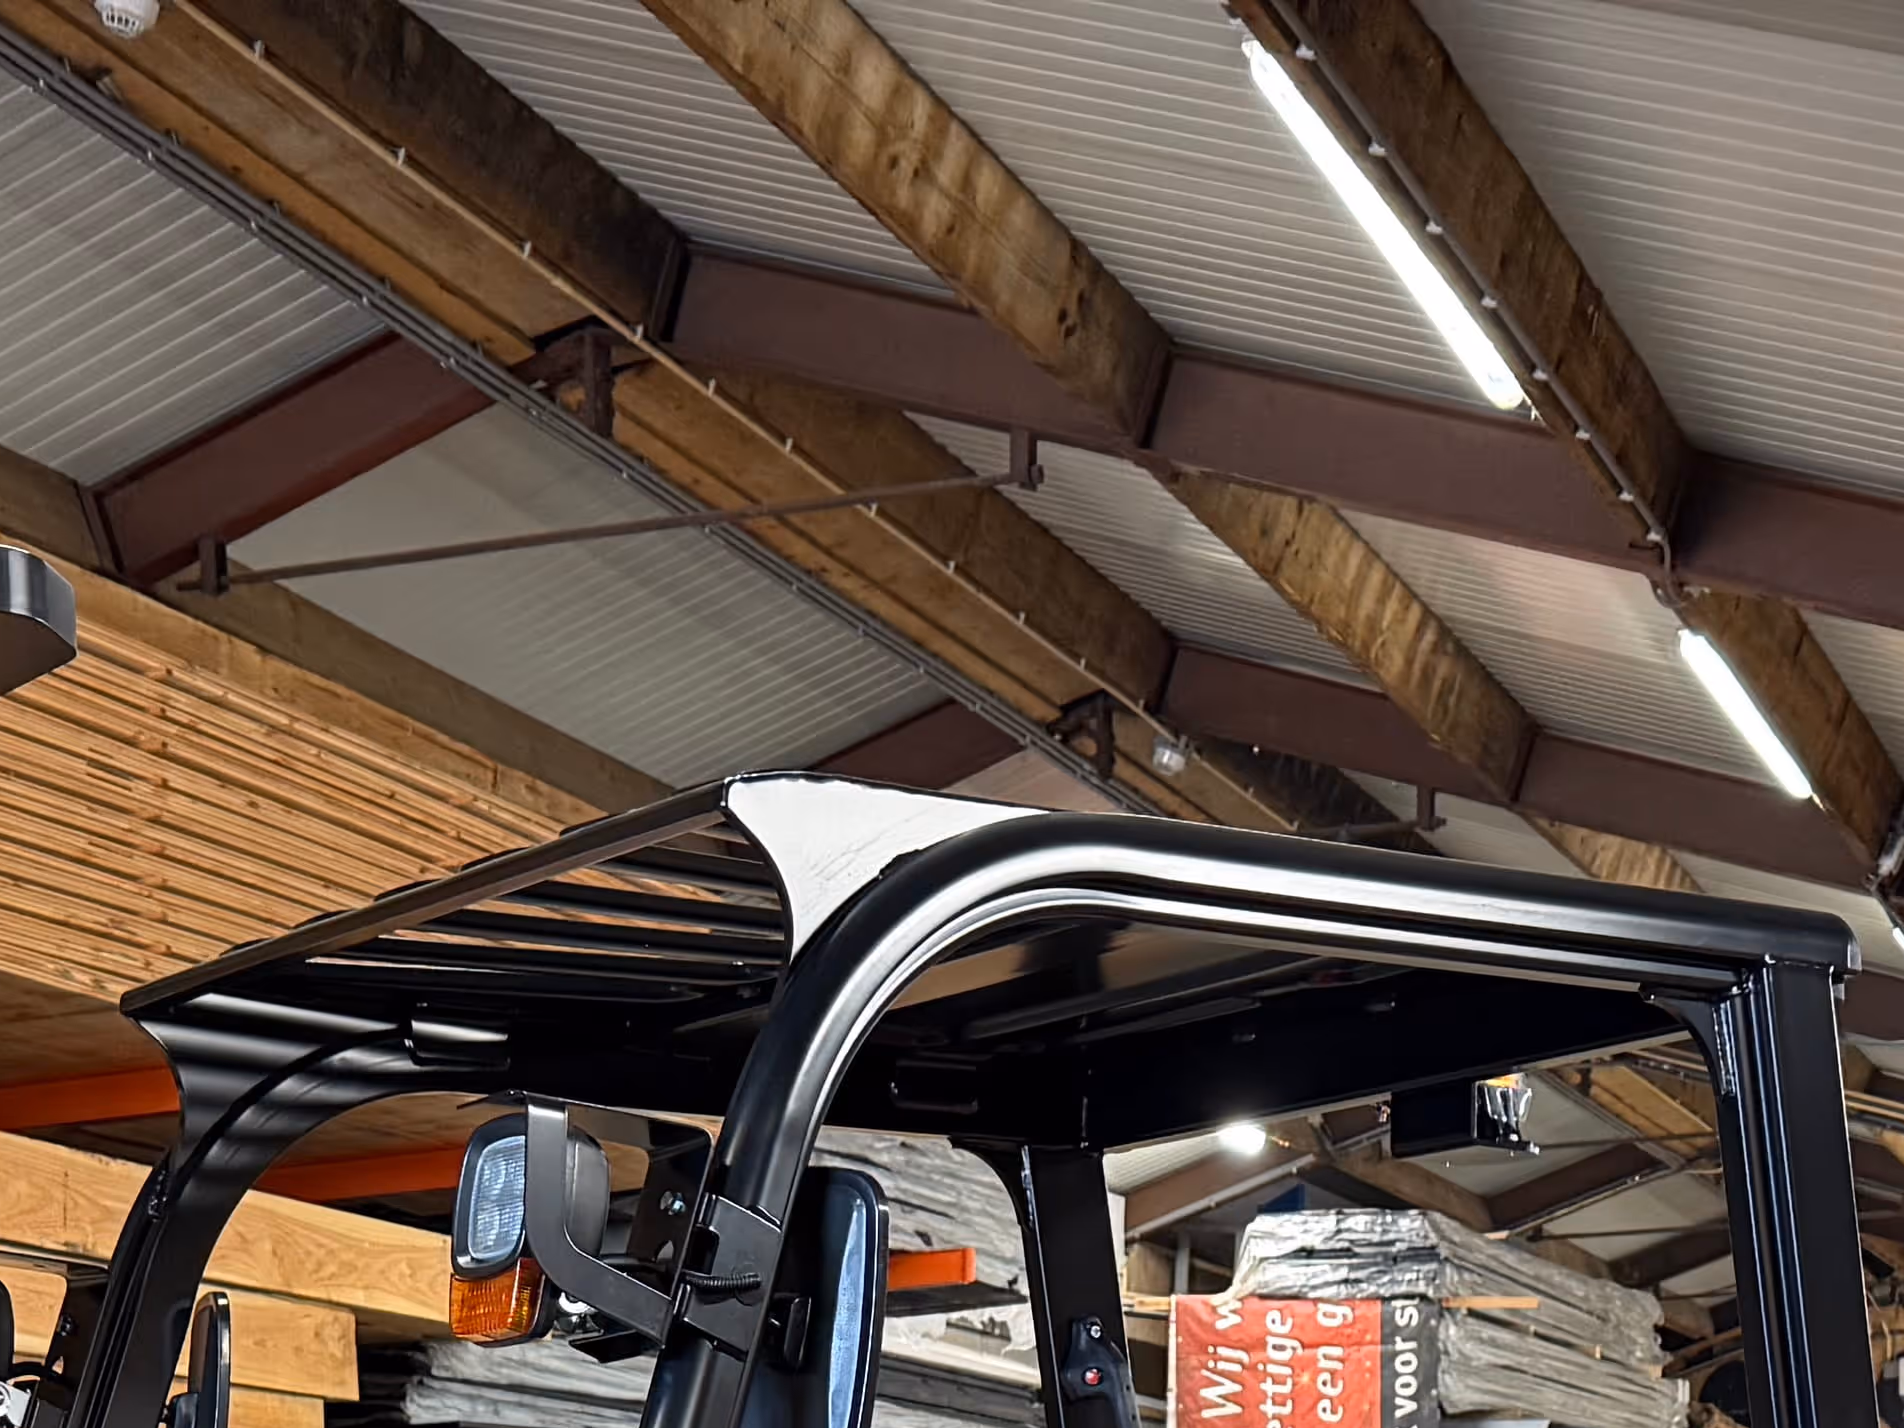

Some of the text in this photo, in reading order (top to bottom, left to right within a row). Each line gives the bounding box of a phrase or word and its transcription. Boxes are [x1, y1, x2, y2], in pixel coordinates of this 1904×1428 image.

[1199, 1344, 1249, 1418] Wij
[1315, 1344, 1344, 1423] een
[1393, 1336, 1419, 1420] voor
